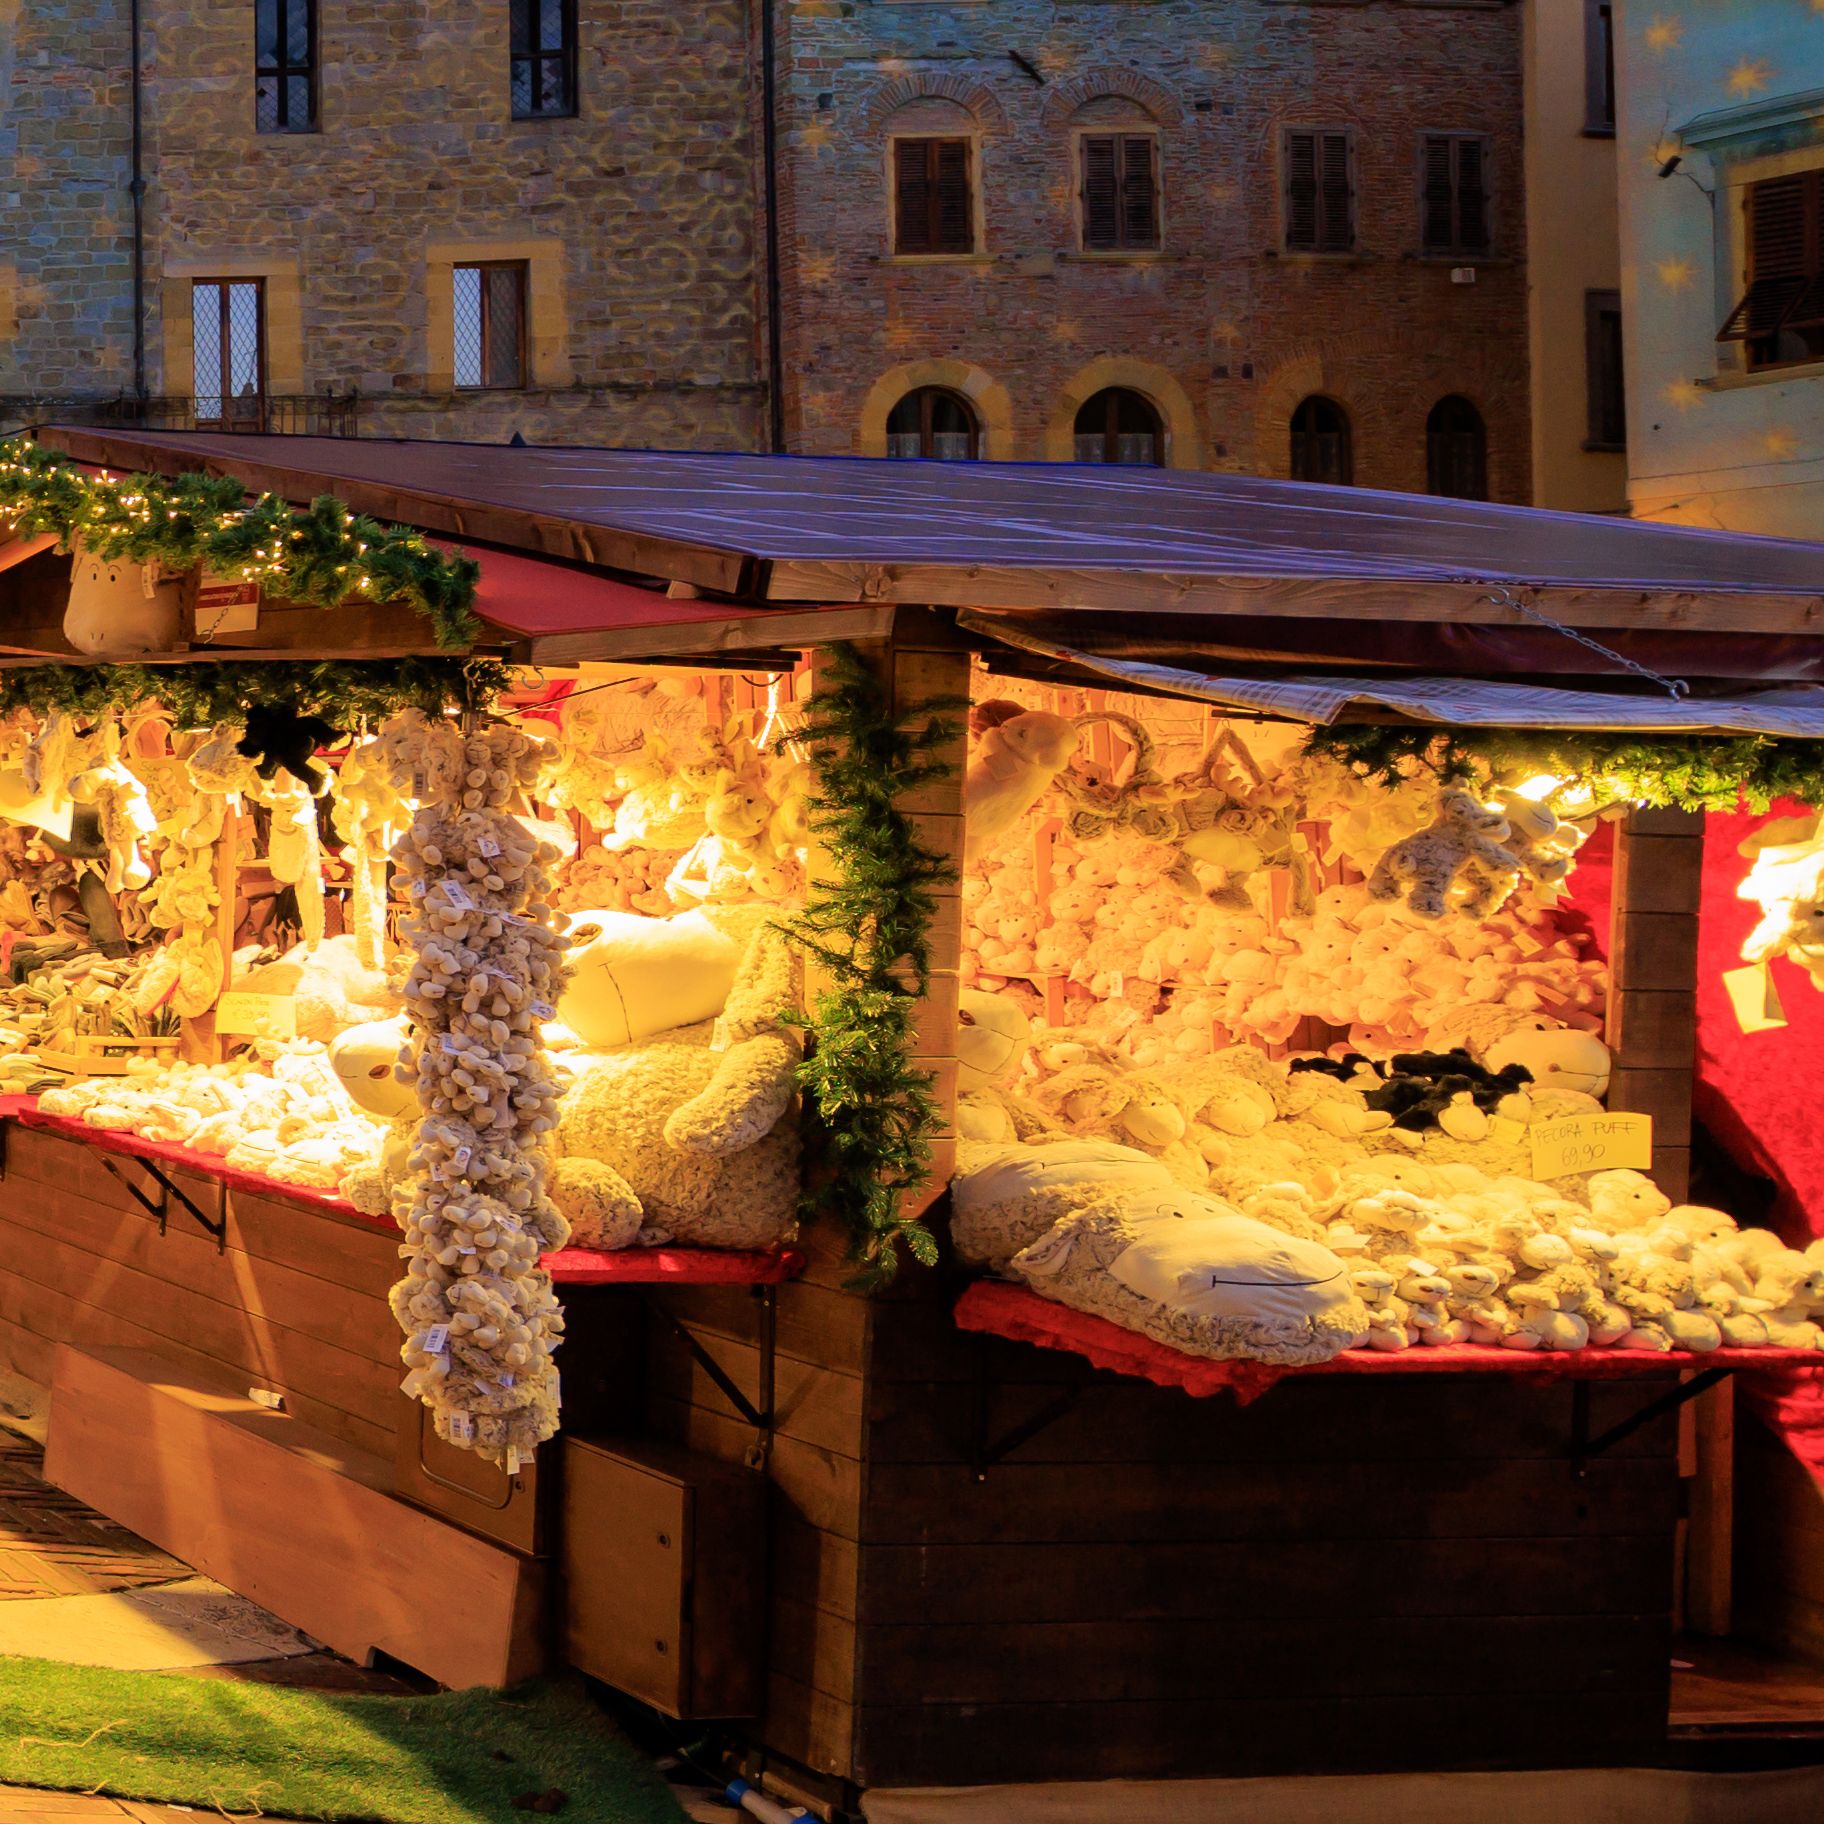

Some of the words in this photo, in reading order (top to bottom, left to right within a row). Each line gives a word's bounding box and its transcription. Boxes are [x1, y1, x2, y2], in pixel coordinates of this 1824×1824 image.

[1535, 1122, 1584, 1146] PECORA
[1592, 1121, 1638, 1135] PUFF
[1561, 1143, 1606, 1167] 69,90
